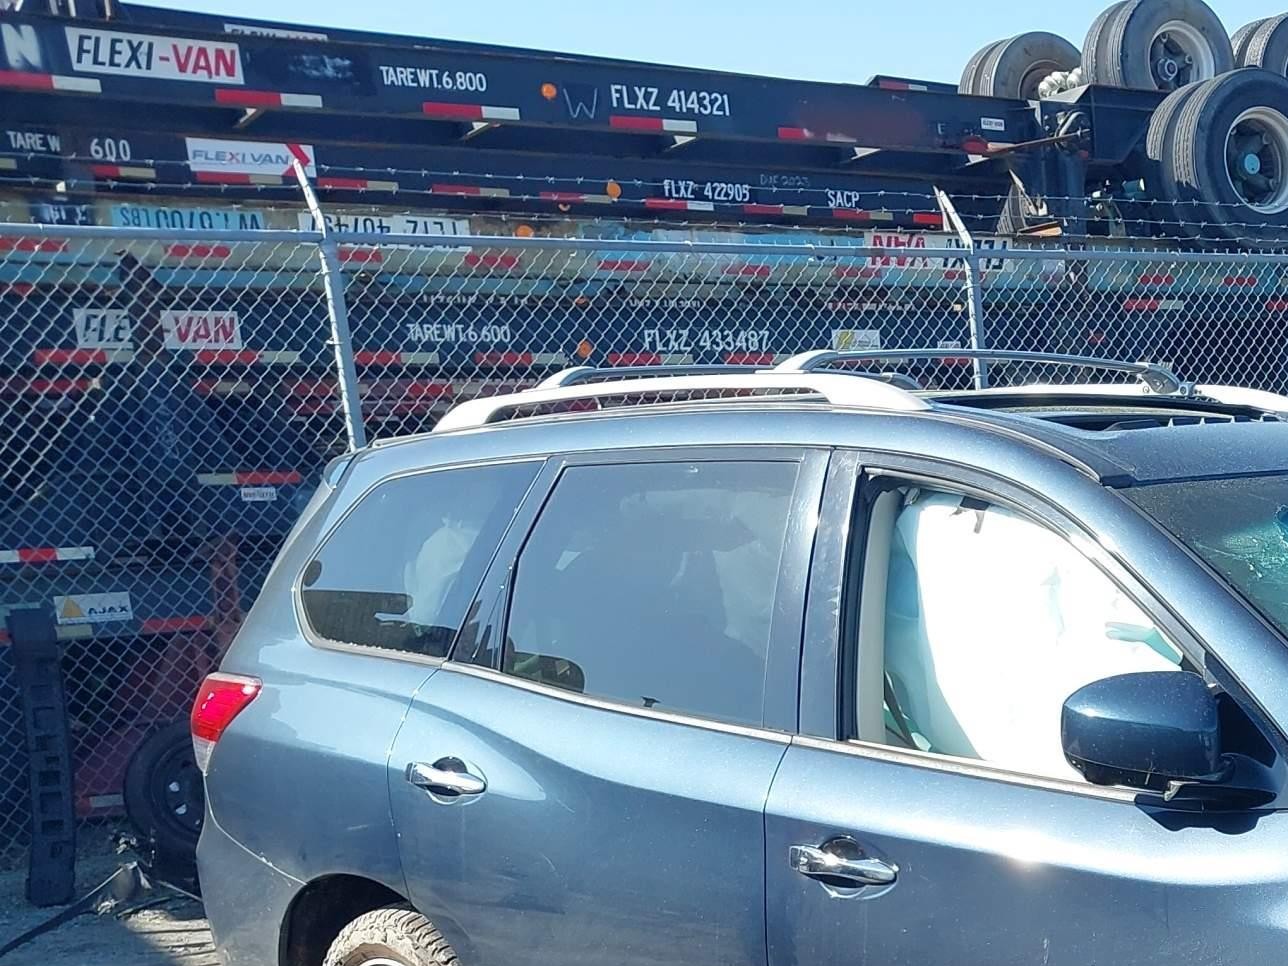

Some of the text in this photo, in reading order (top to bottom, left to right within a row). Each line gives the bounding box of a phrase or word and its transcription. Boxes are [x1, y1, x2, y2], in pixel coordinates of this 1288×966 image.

[610, 84, 731, 116] FLXZ 414321
[664, 179, 750, 202] FLXZ 422905
[827, 190, 860, 208] SACP
[644, 329, 769, 351] FLXZ 433487
[88, 605, 128, 615] AJAX
